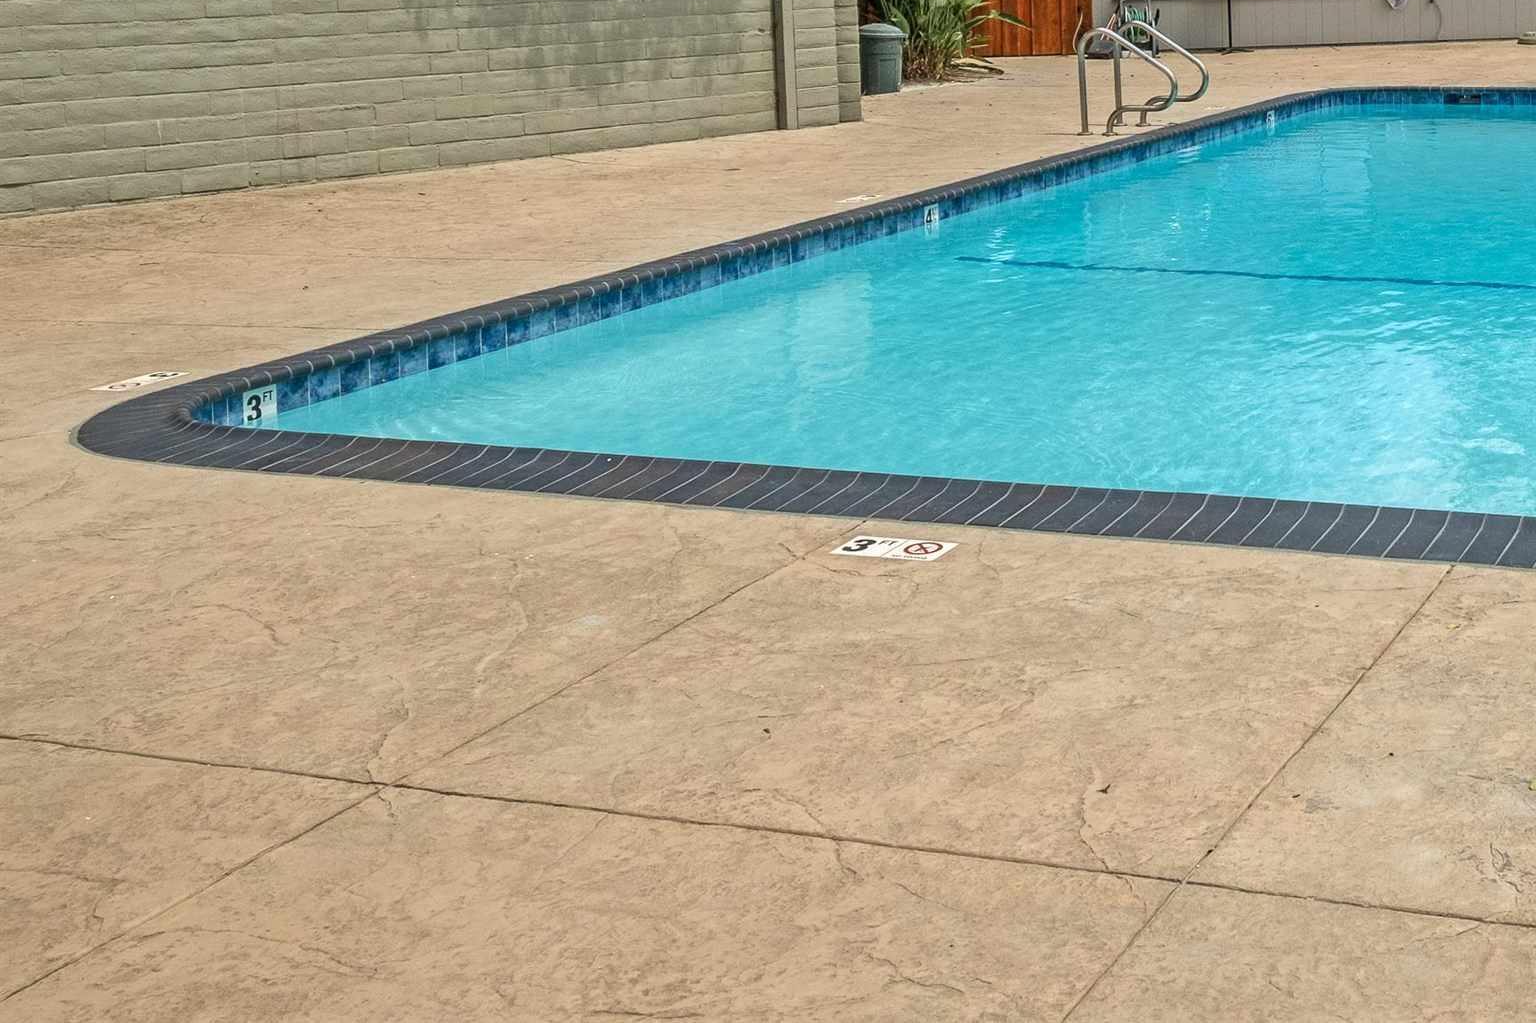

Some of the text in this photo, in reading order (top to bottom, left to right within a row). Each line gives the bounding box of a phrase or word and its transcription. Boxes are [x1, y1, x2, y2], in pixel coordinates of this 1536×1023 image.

[926, 208, 933, 223] 4
[247, 390, 274, 421] 3 FT
[841, 539, 877, 552] 3
